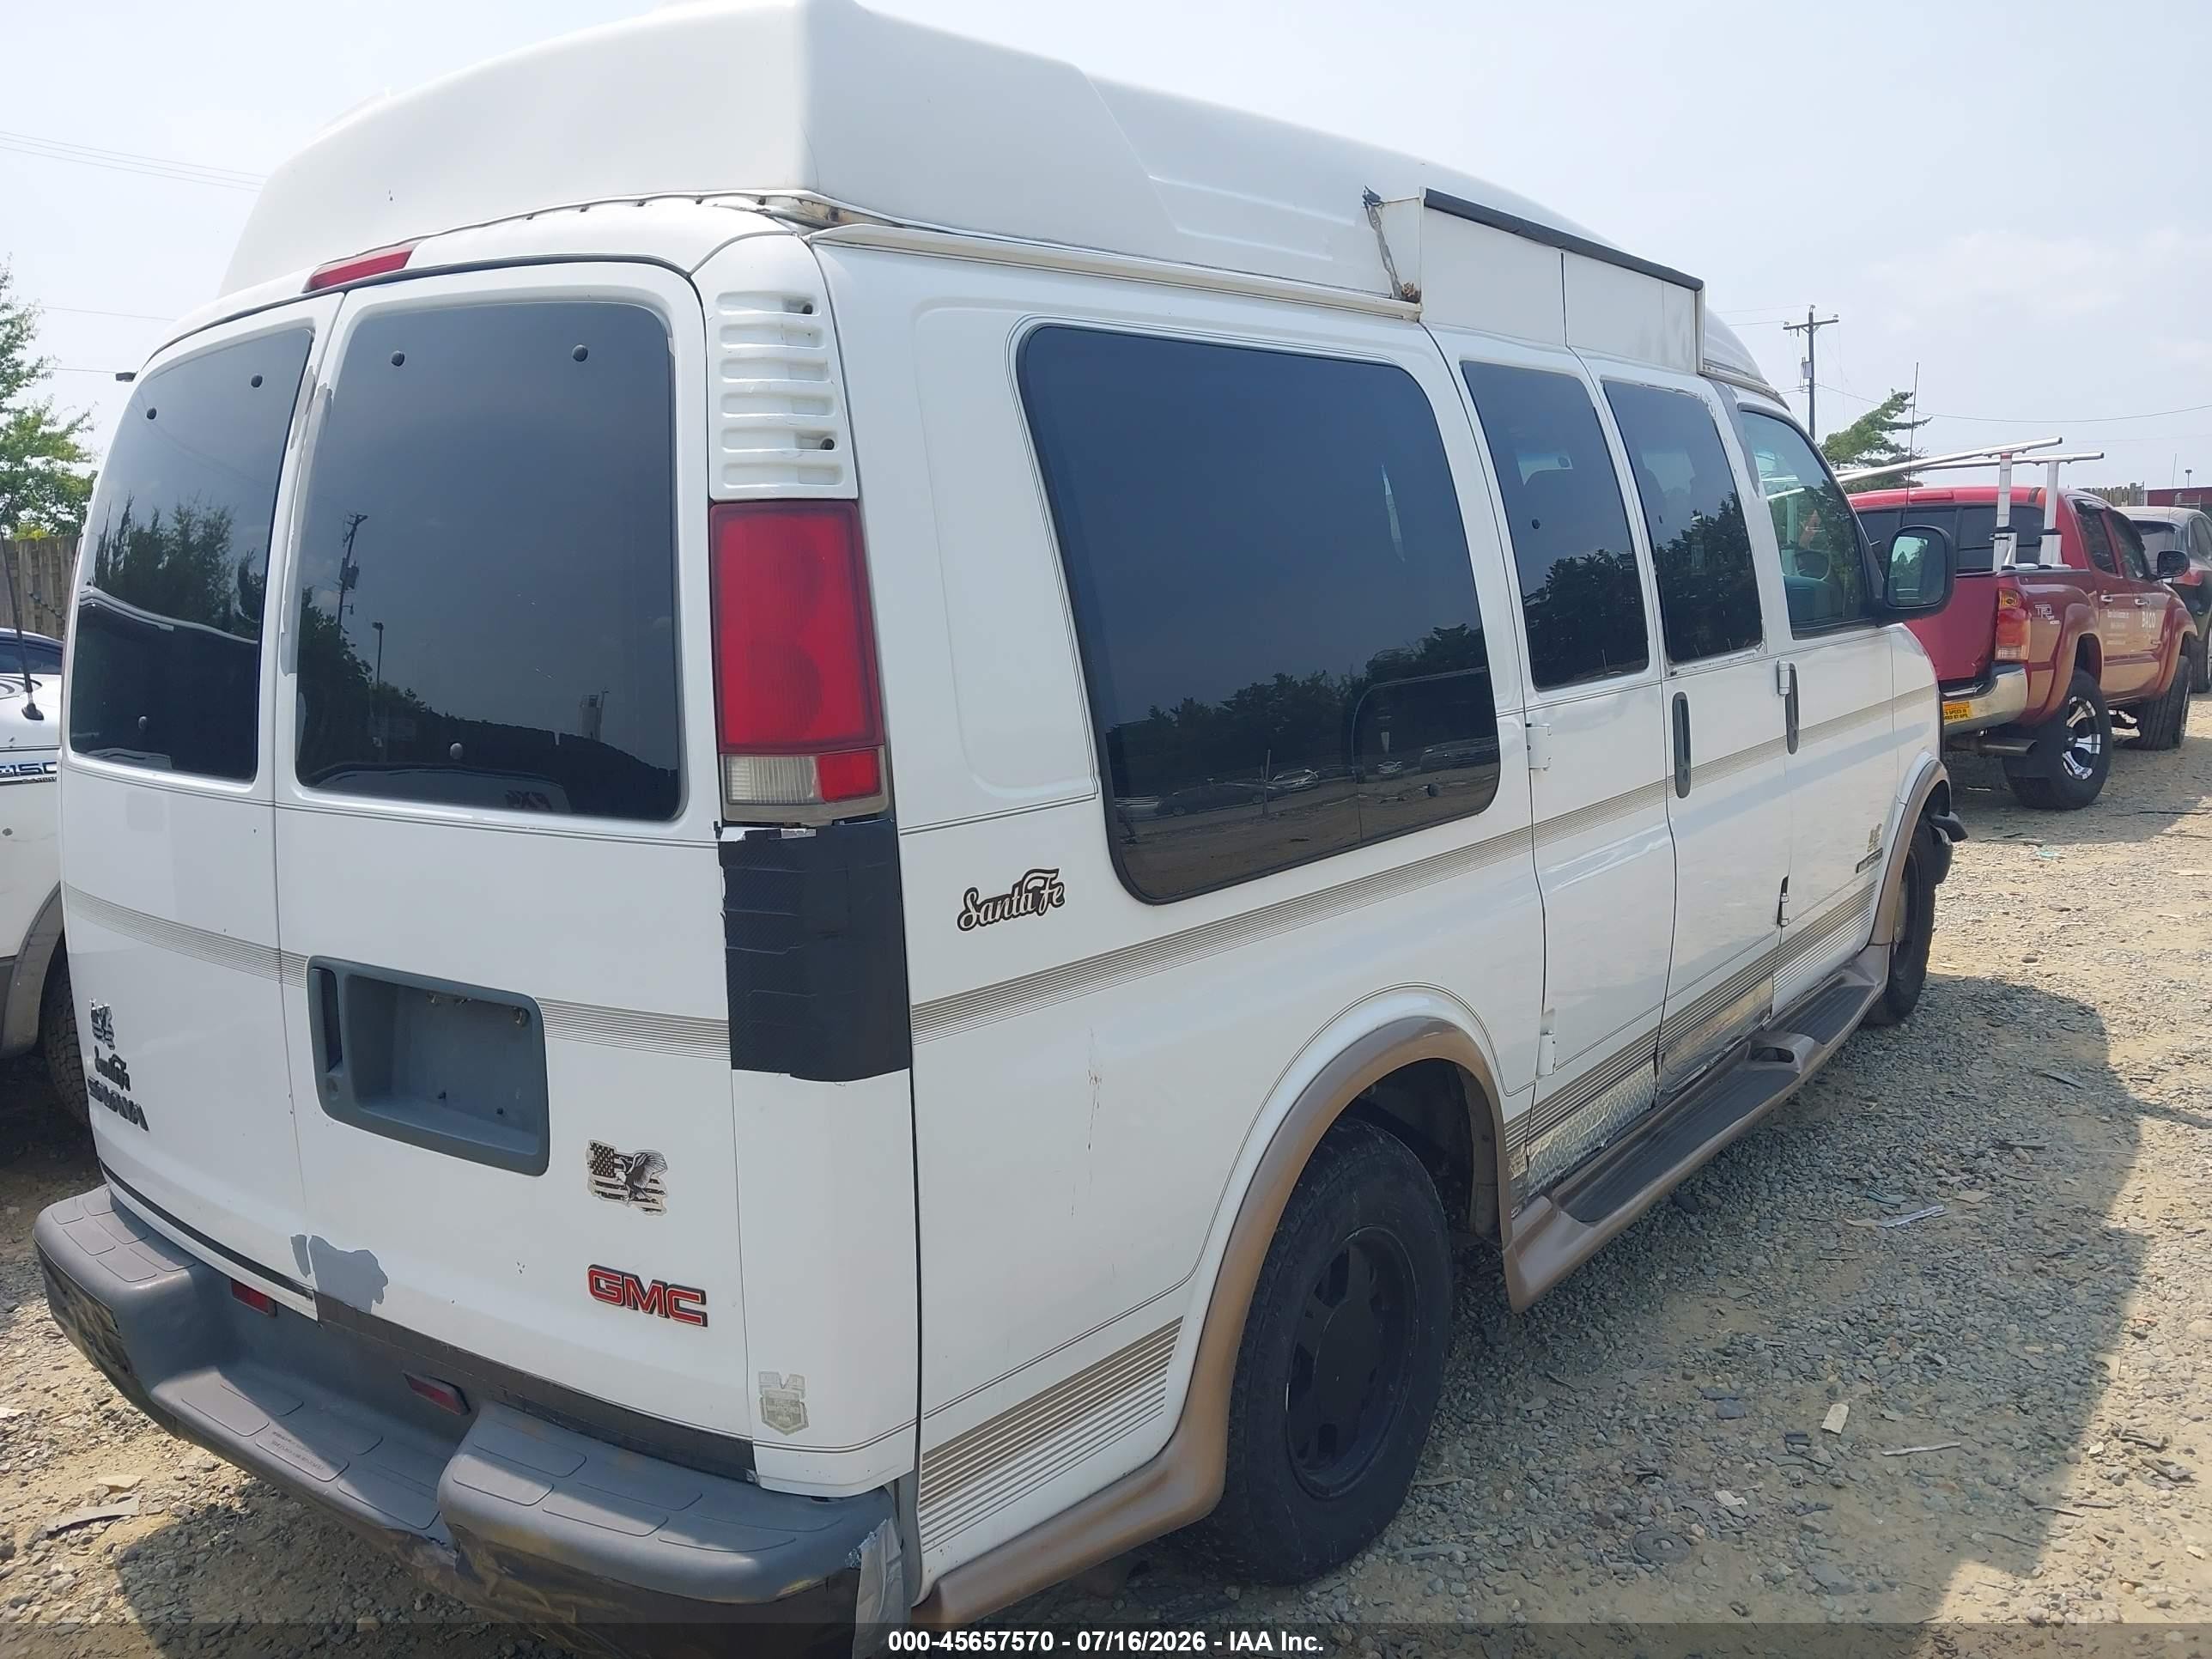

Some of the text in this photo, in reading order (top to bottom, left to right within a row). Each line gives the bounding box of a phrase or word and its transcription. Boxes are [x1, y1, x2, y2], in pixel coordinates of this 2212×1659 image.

[957, 867, 1066, 932] Santa Fe
[588, 1264, 708, 1328] GMC
